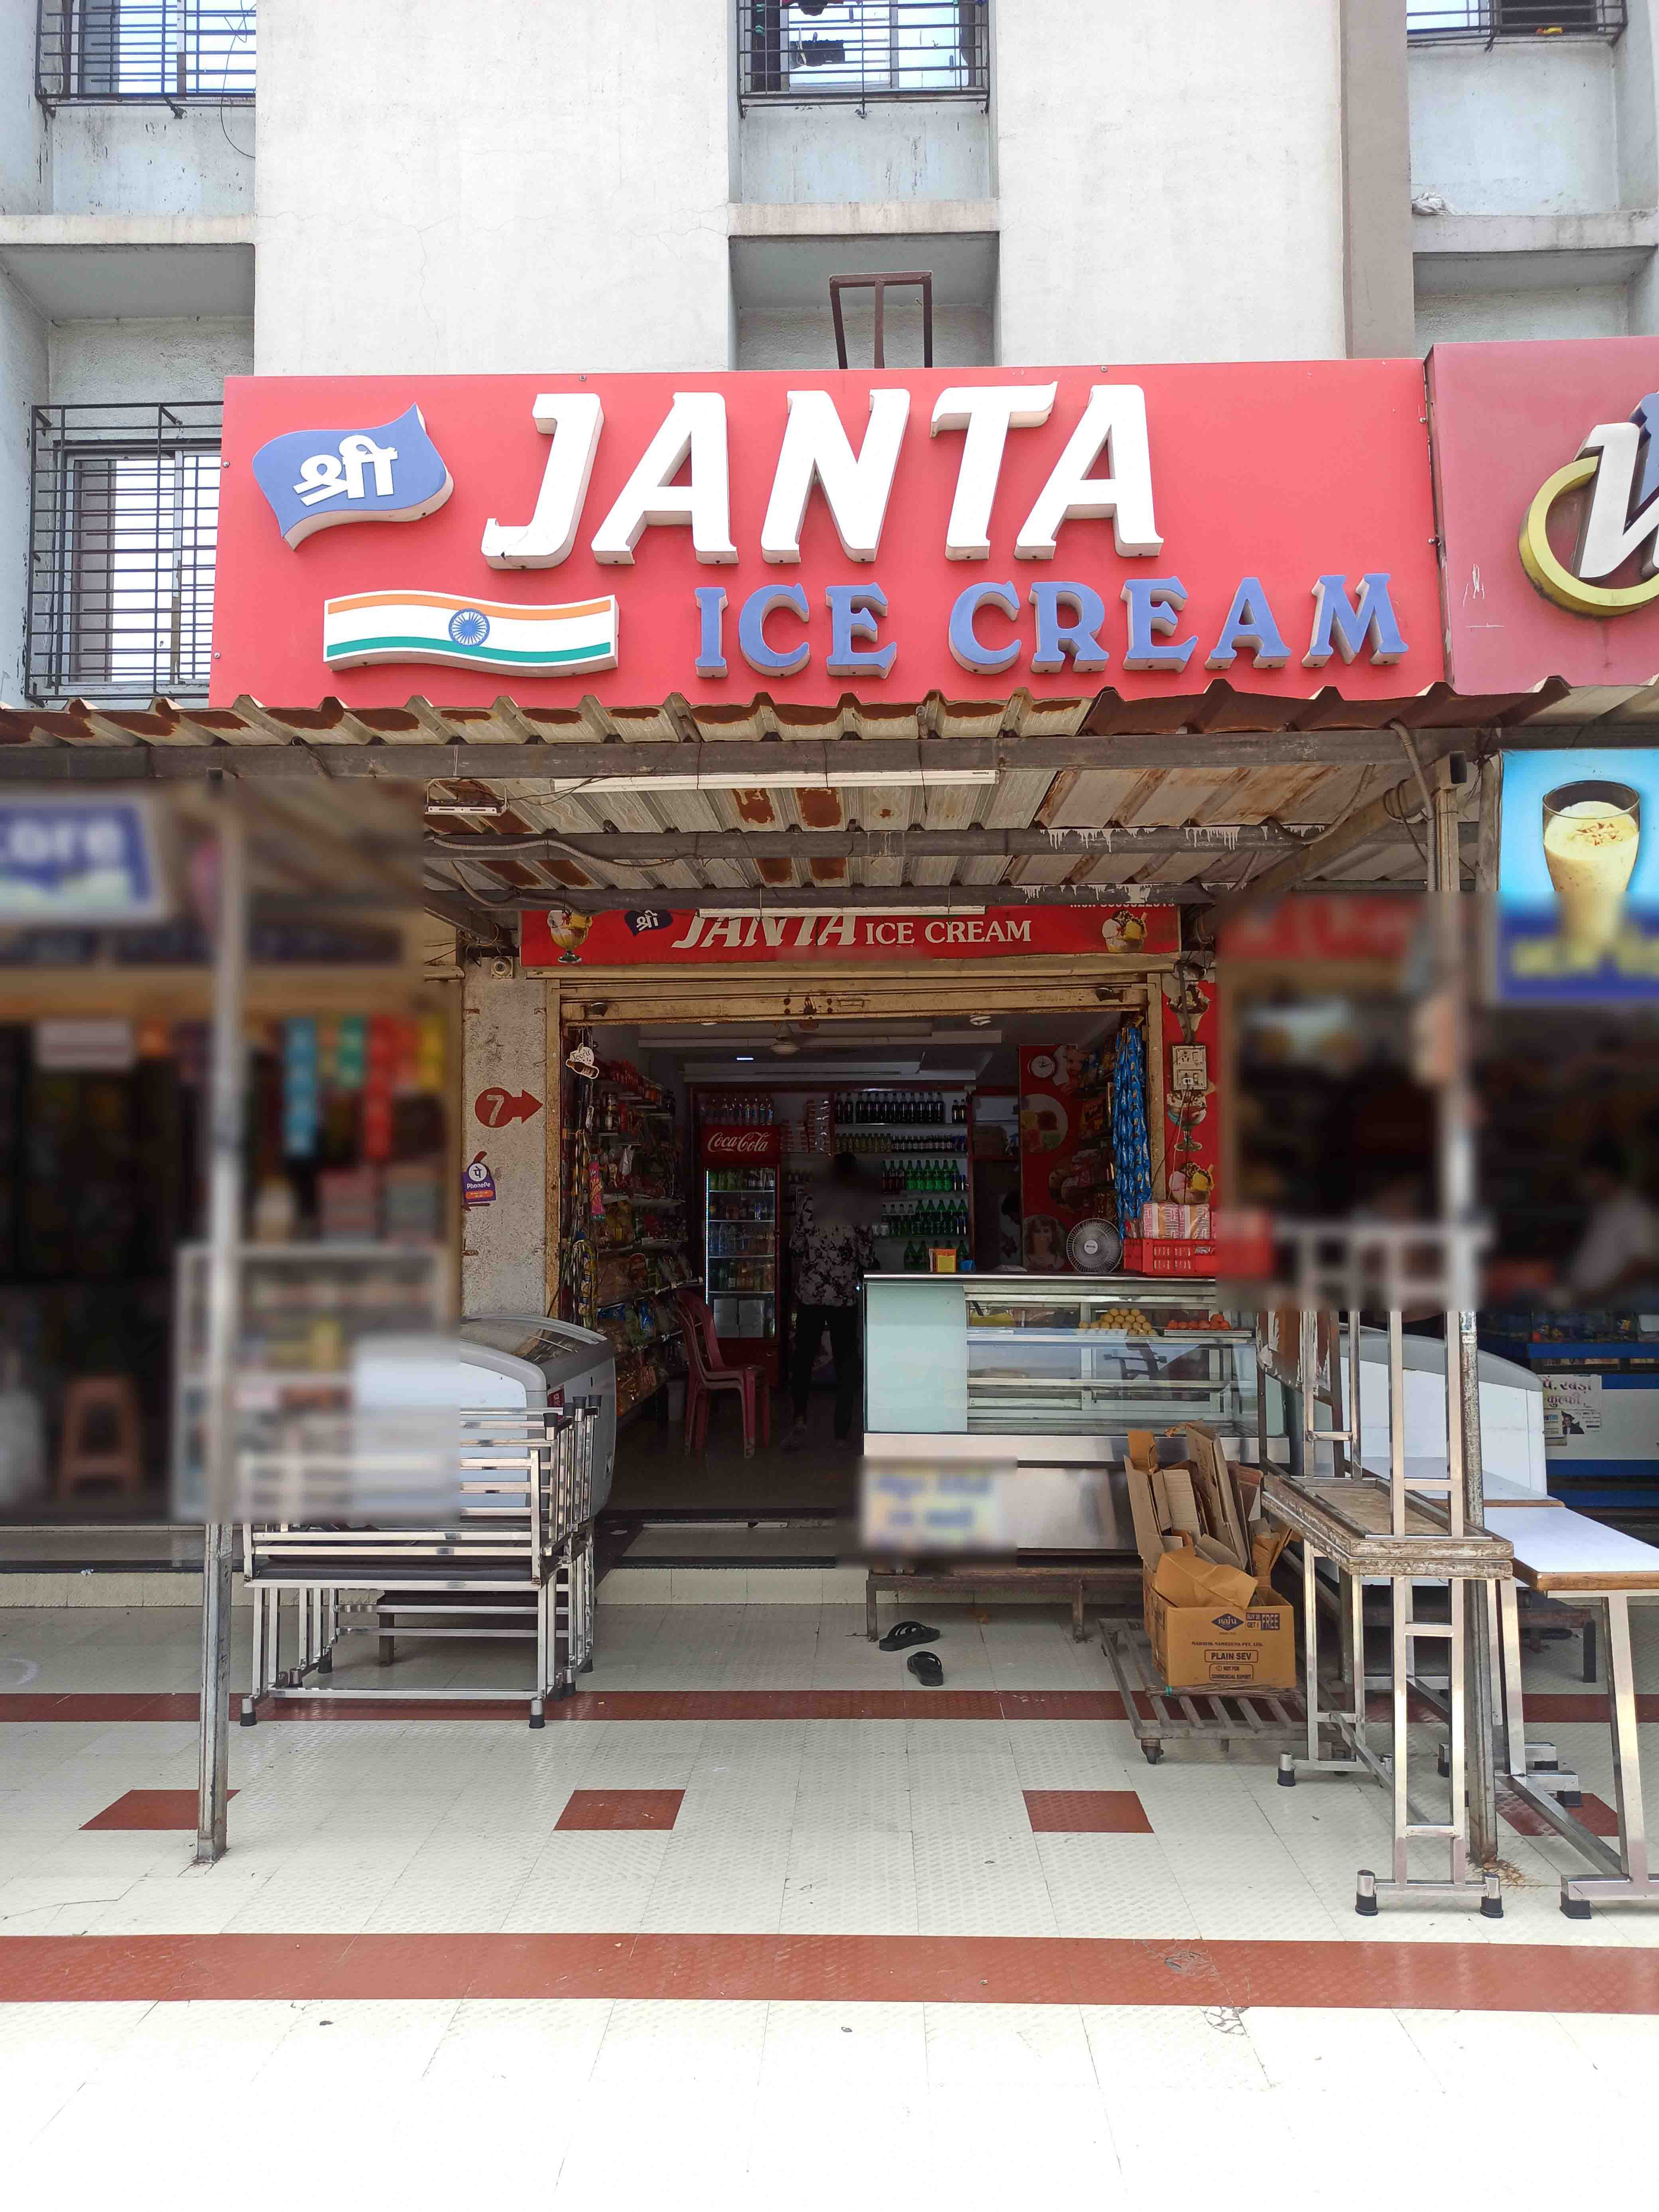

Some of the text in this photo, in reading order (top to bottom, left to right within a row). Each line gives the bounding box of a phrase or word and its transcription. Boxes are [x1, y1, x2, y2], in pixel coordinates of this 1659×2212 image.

[293, 435, 398, 506] श्री
[481, 381, 1164, 569] JANTA
[695, 573, 1409, 678] ICE CREAM
[636, 909, 659, 931] श्री
[866, 922, 915, 945] ICE
[925, 920, 1032, 944] CREAM
[486, 1094, 504, 1126] 7
[1261, 1614, 1279, 1629] FREE
